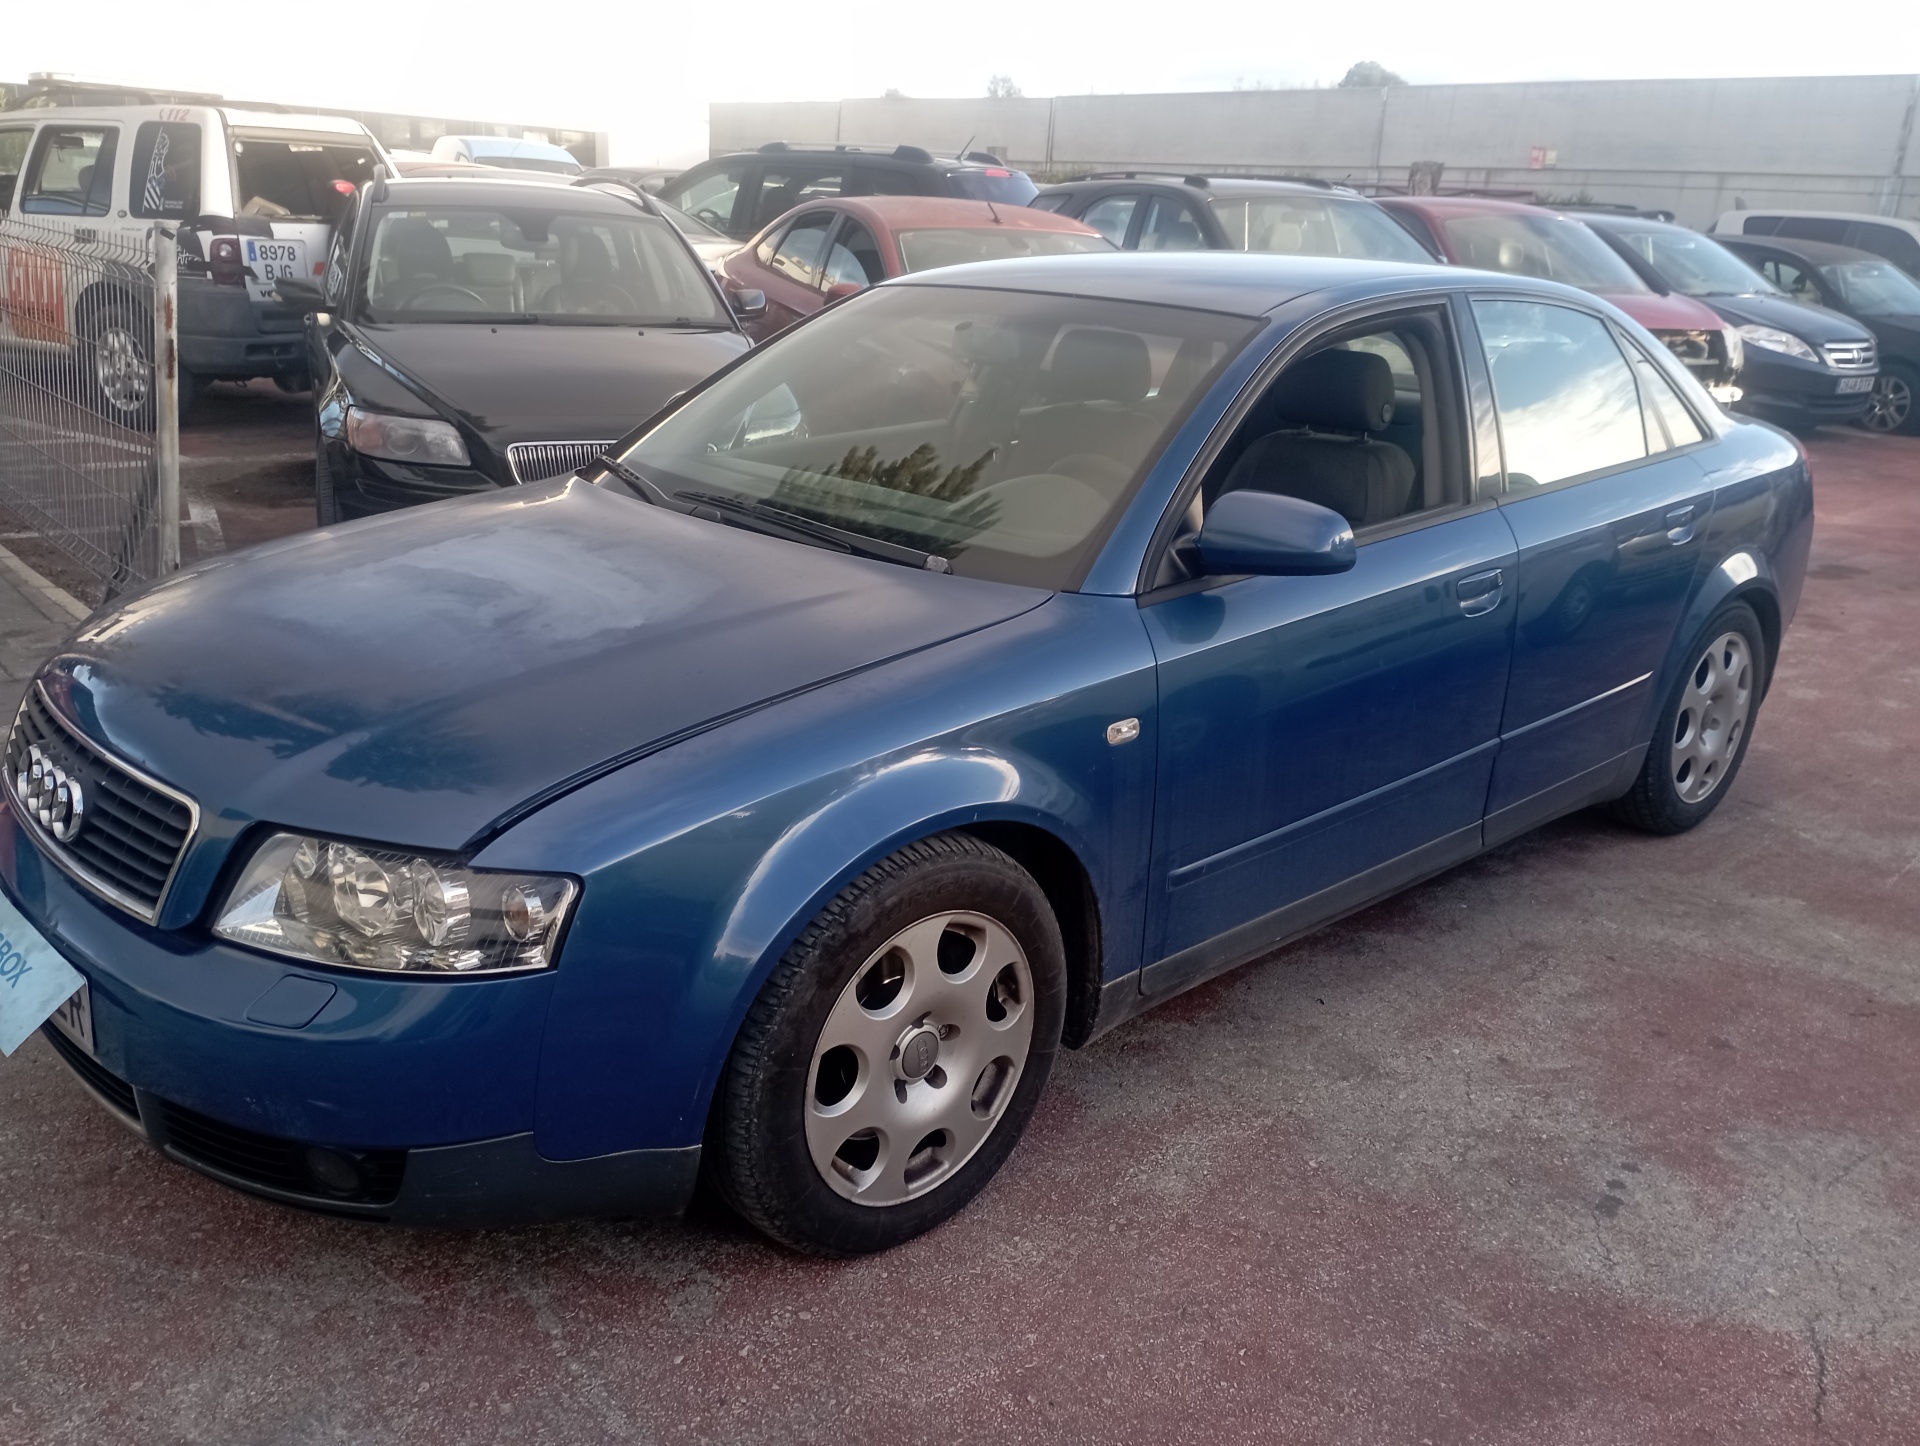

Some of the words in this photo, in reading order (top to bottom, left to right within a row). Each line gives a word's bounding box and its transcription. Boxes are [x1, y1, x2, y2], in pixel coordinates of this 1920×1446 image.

[167, 108, 191, 121] 112
[259, 245, 296, 261] 8978
[265, 264, 293, 280] BJG
[0, 933, 33, 989] BOX
